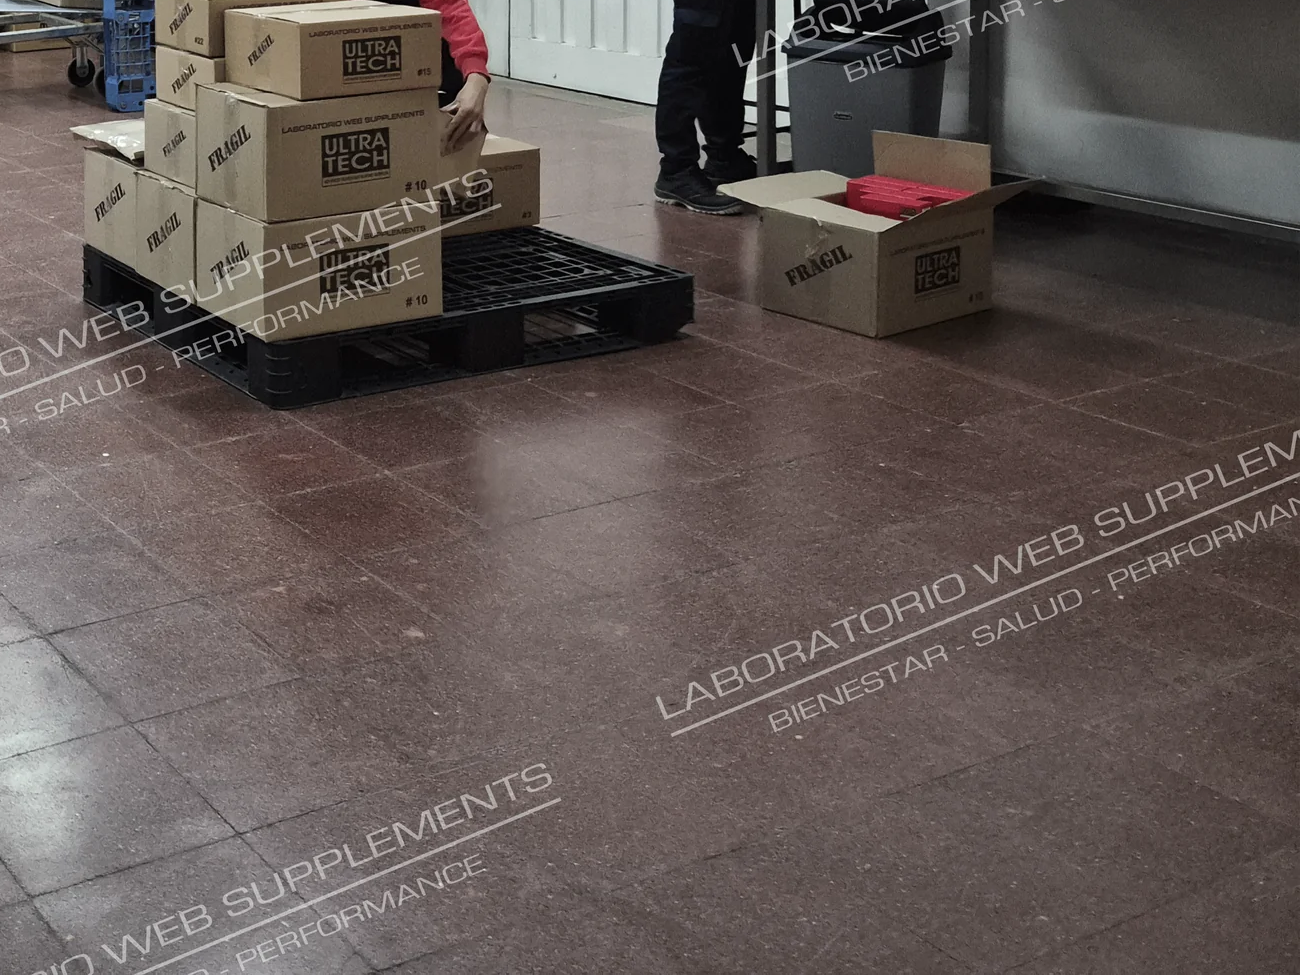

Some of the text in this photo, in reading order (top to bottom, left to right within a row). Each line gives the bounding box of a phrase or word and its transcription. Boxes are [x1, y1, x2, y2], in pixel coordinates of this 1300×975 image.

[169, 2, 193, 35] FRAGIL
[309, 27, 360, 38] LABORATORIO
[379, 22, 433, 32] SUPPLEMENTS
[247, 34, 274, 67] FRAGIL
[345, 39, 399, 57] ULTRA
[344, 55, 400, 73] TECH
[171, 63, 197, 94] FRAGIL
[281, 109, 425, 134] LABORATORIO WEB SUPPLEMENTS
[162, 130, 187, 158] FRAGIL
[207, 125, 251, 172] FRAGIL
[324, 132, 387, 154] ULTRA
[324, 149, 388, 173] TECH
[94, 183, 126, 222] FRAGIL
[146, 212, 182, 253] FRAGIL
[363, 225, 426, 240] SUPPLEMENTS
[209, 240, 250, 285] FRAGIL
[322, 248, 387, 270] ULTRA
[784, 244, 853, 287] FRAGIL
[916, 250, 958, 273] ULTRA
[322, 265, 388, 290] TECH
[916, 266, 959, 289] TECH
[416, 295, 428, 305] 10
